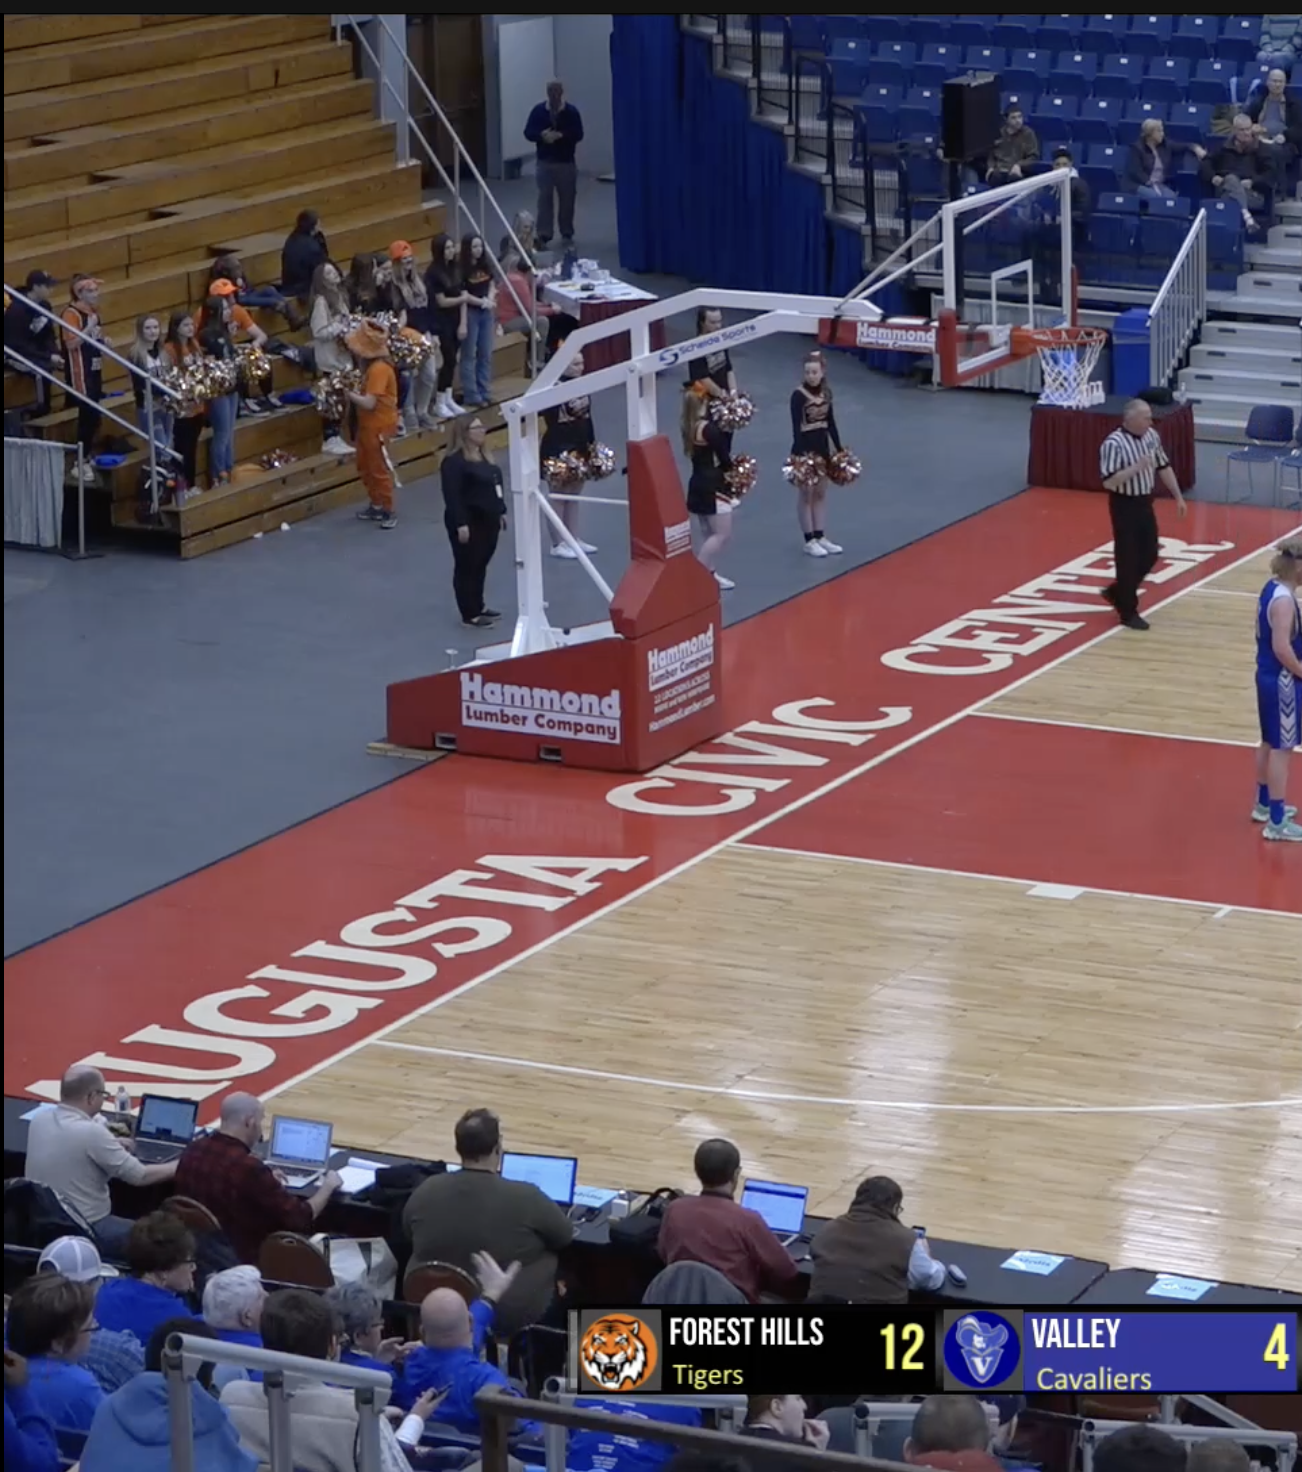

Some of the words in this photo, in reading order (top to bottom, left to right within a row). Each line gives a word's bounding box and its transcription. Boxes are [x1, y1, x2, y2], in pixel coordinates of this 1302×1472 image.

[721, 323, 757, 343] Sports
[857, 321, 936, 342] Hammond
[647, 622, 714, 673] Hammond
[460, 672, 621, 718] Hammond
[465, 704, 528, 727] Lumber
[534, 713, 617, 741] Company
[606, 697, 912, 816] CIVIC
